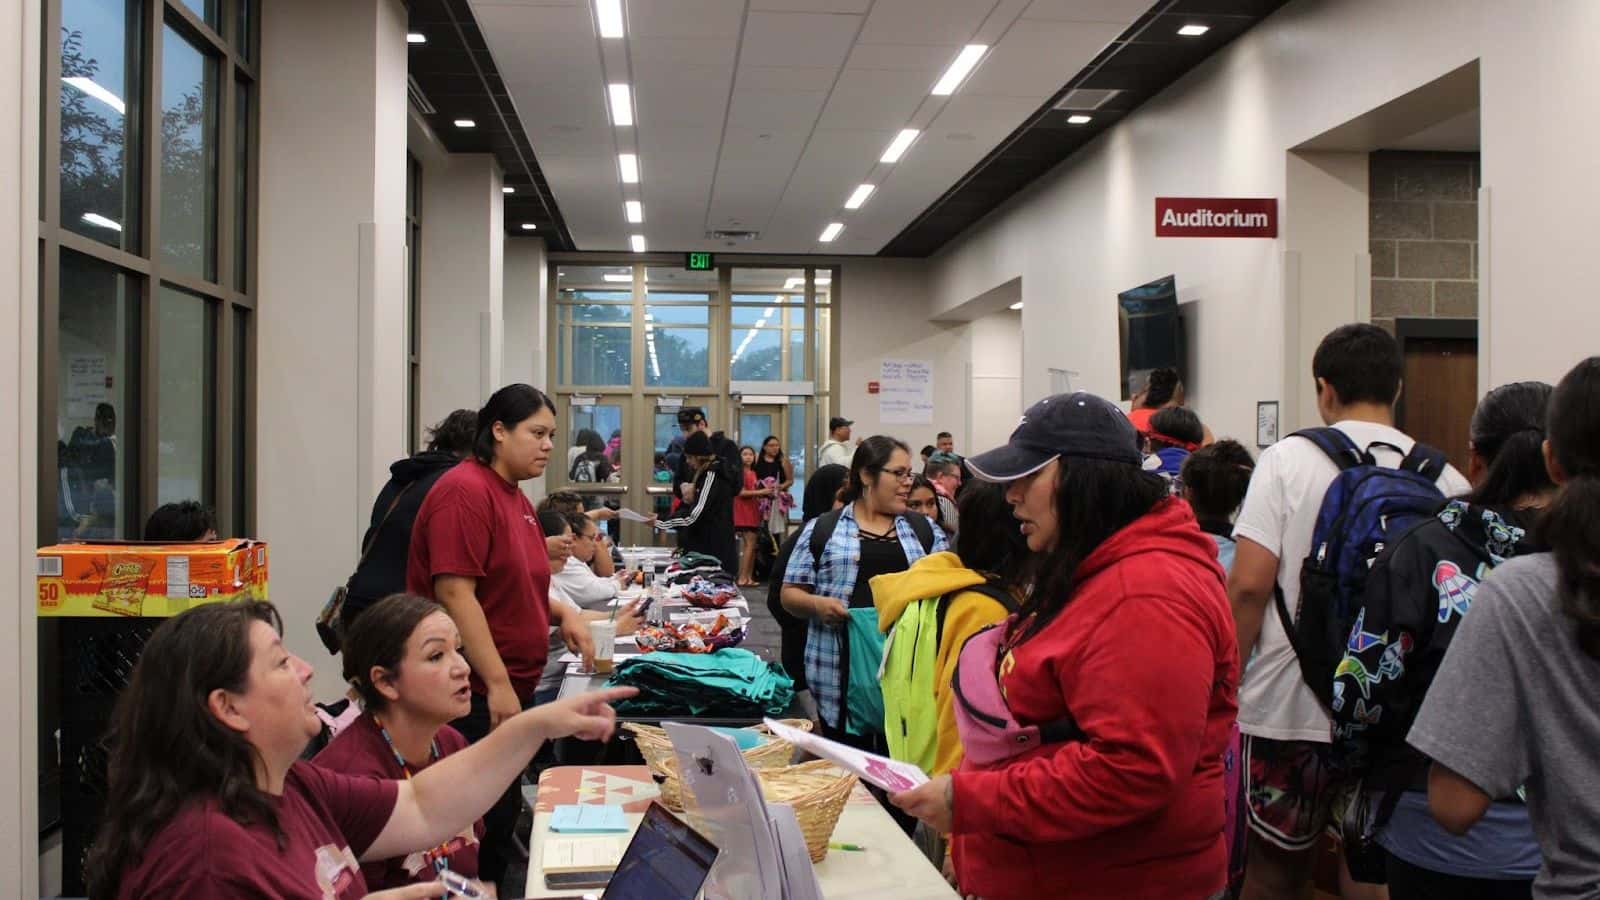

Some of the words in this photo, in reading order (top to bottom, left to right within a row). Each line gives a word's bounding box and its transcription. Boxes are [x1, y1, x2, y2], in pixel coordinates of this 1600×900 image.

[1161, 208, 1269, 228] Auditorium
[690, 253, 710, 268] EXIT
[39, 582, 58, 600] 50
